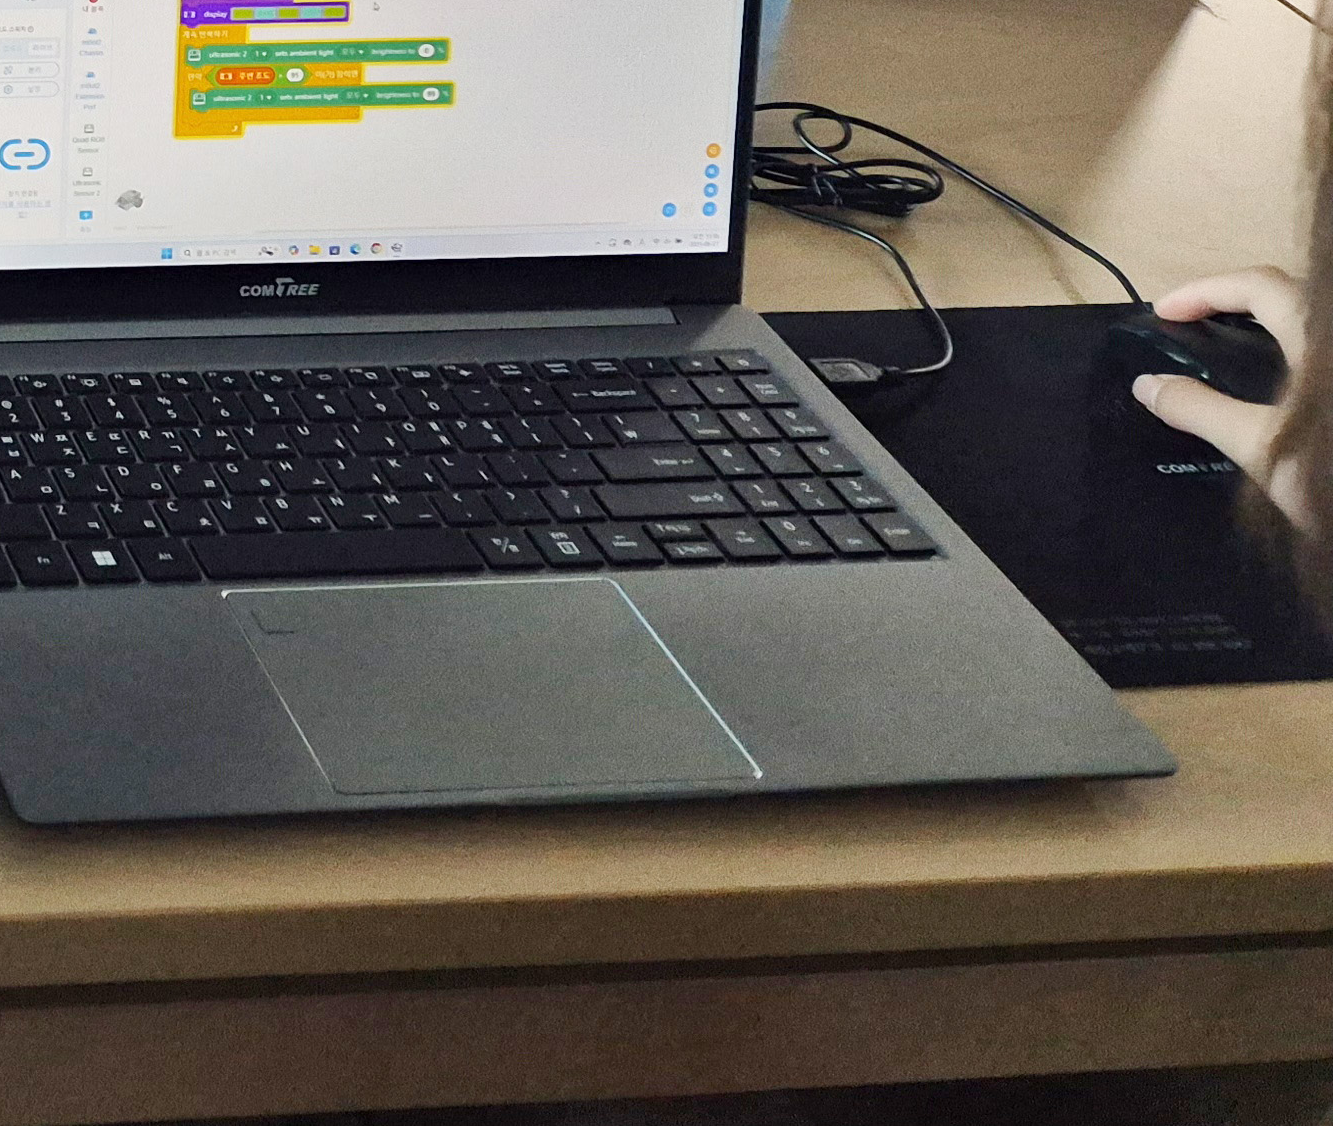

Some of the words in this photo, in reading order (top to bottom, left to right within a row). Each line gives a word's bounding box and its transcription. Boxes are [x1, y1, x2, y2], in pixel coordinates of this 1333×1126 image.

[239, 277, 321, 298] COMTREE
[37, 556, 50, 565] Fn
[158, 552, 173, 561] Alt
